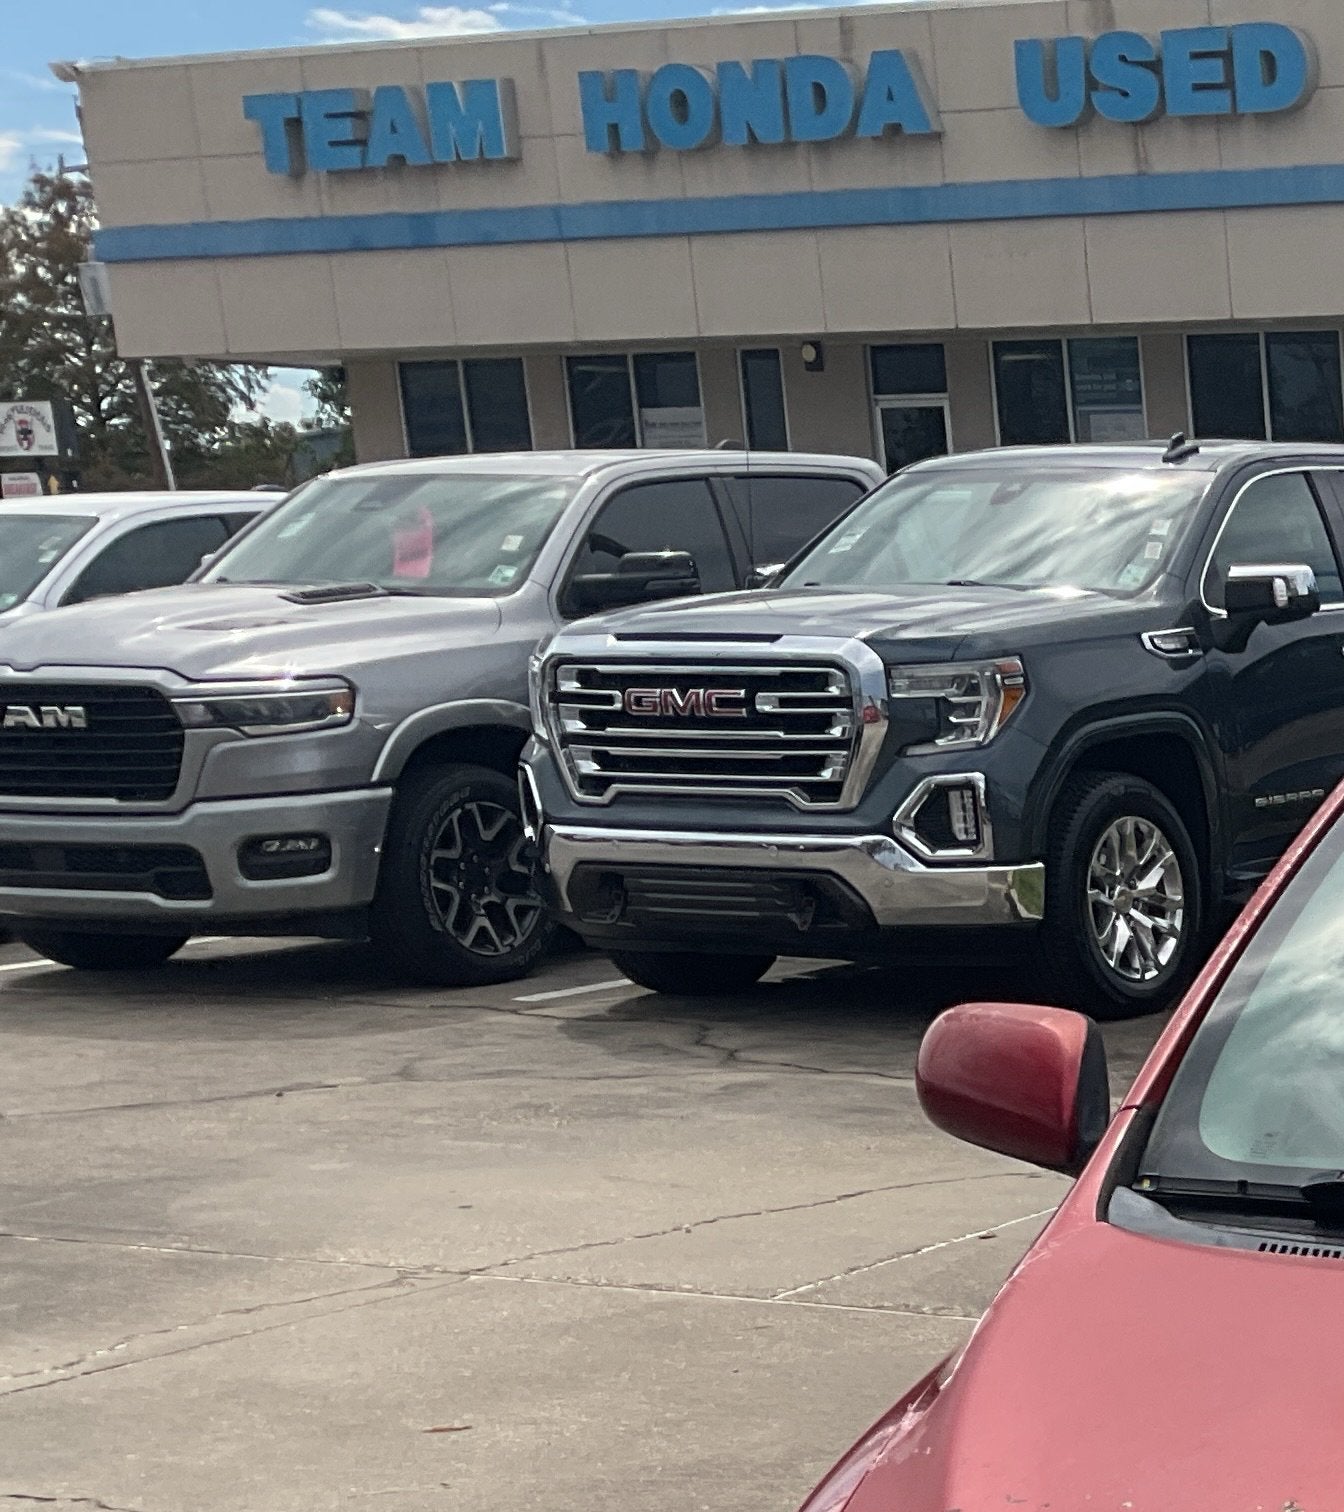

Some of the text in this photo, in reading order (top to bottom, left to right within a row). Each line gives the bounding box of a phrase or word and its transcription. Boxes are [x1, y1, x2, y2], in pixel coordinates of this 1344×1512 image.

[243, 79, 510, 174] TEAM
[578, 50, 934, 153] HONDA
[1014, 22, 1312, 127] USED
[2, 705, 88, 728] AM
[624, 687, 748, 718] GMC
